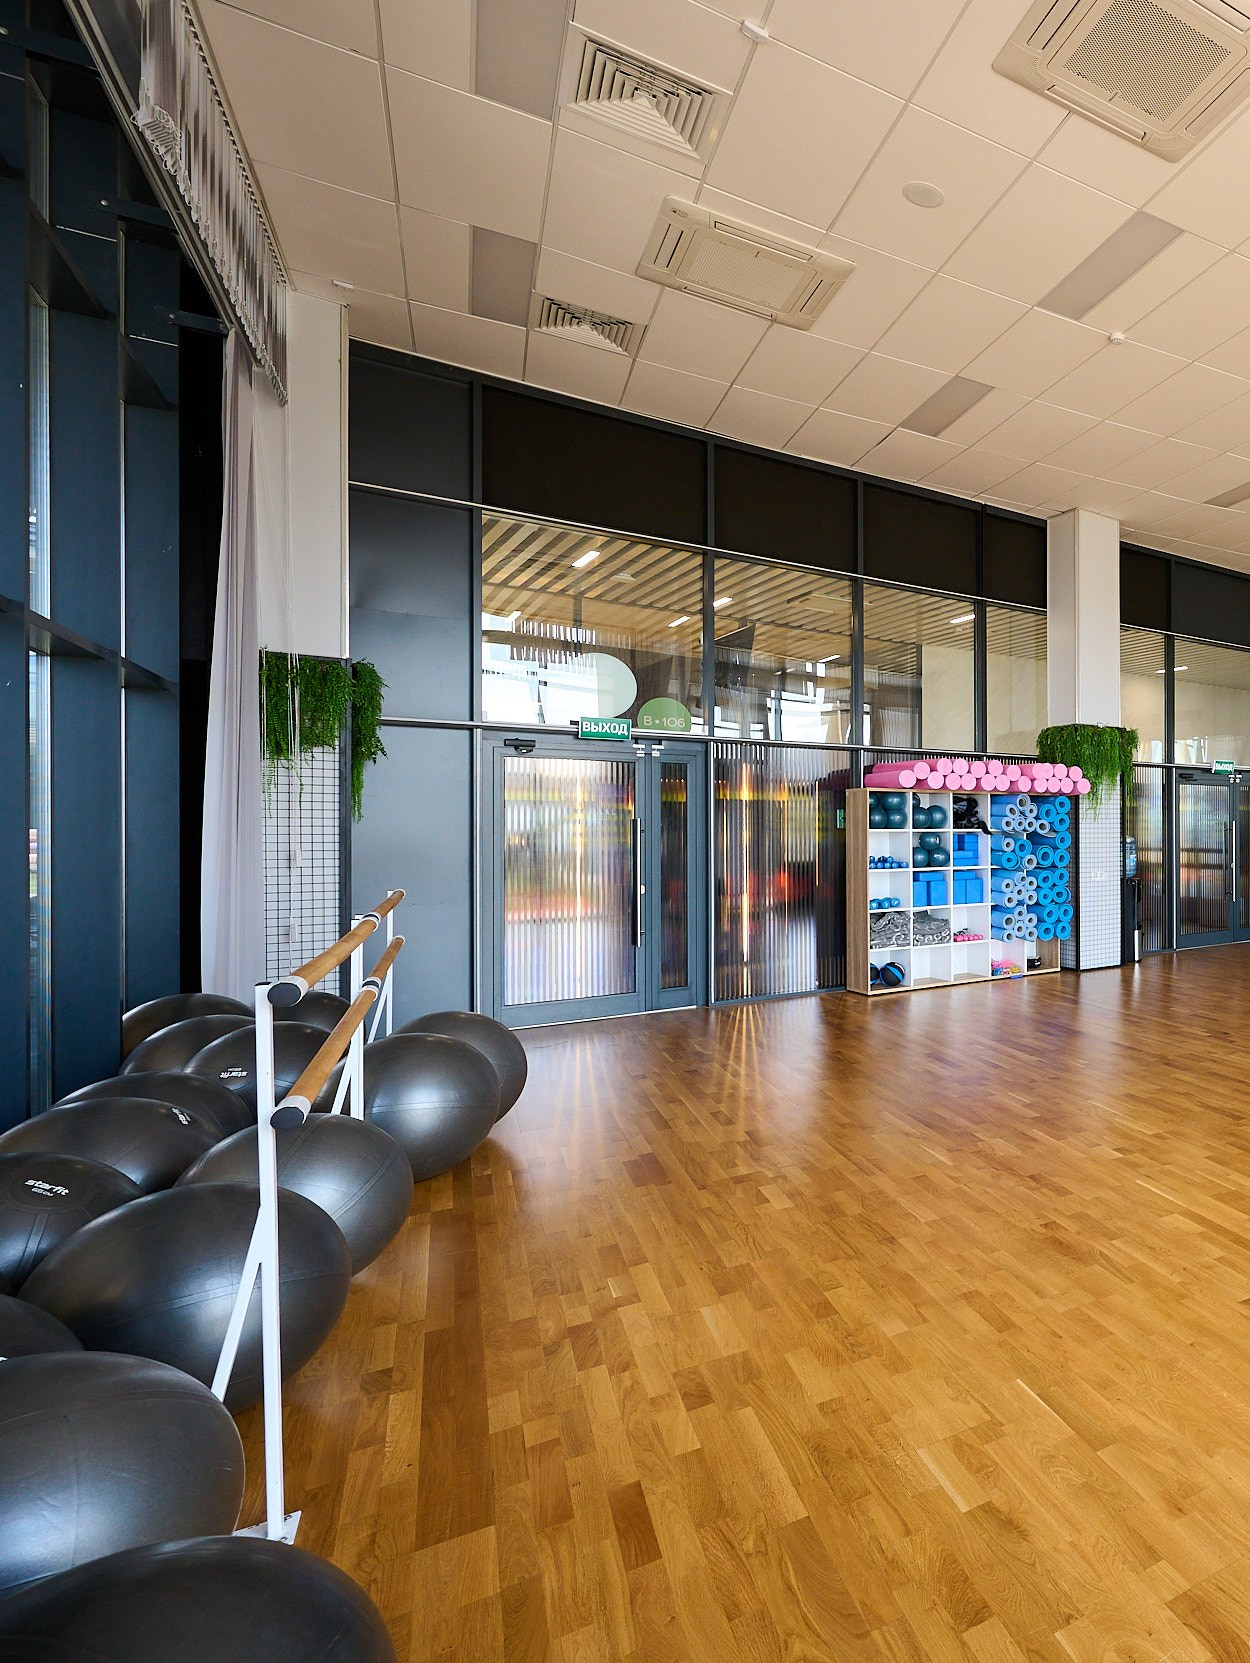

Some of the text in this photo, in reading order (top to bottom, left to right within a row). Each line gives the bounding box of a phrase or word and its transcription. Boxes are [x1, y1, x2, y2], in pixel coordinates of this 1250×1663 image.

[582, 721, 629, 736] ВЫХОД
[662, 716, 685, 728] 106
[24, 1179, 69, 1196] starfit
